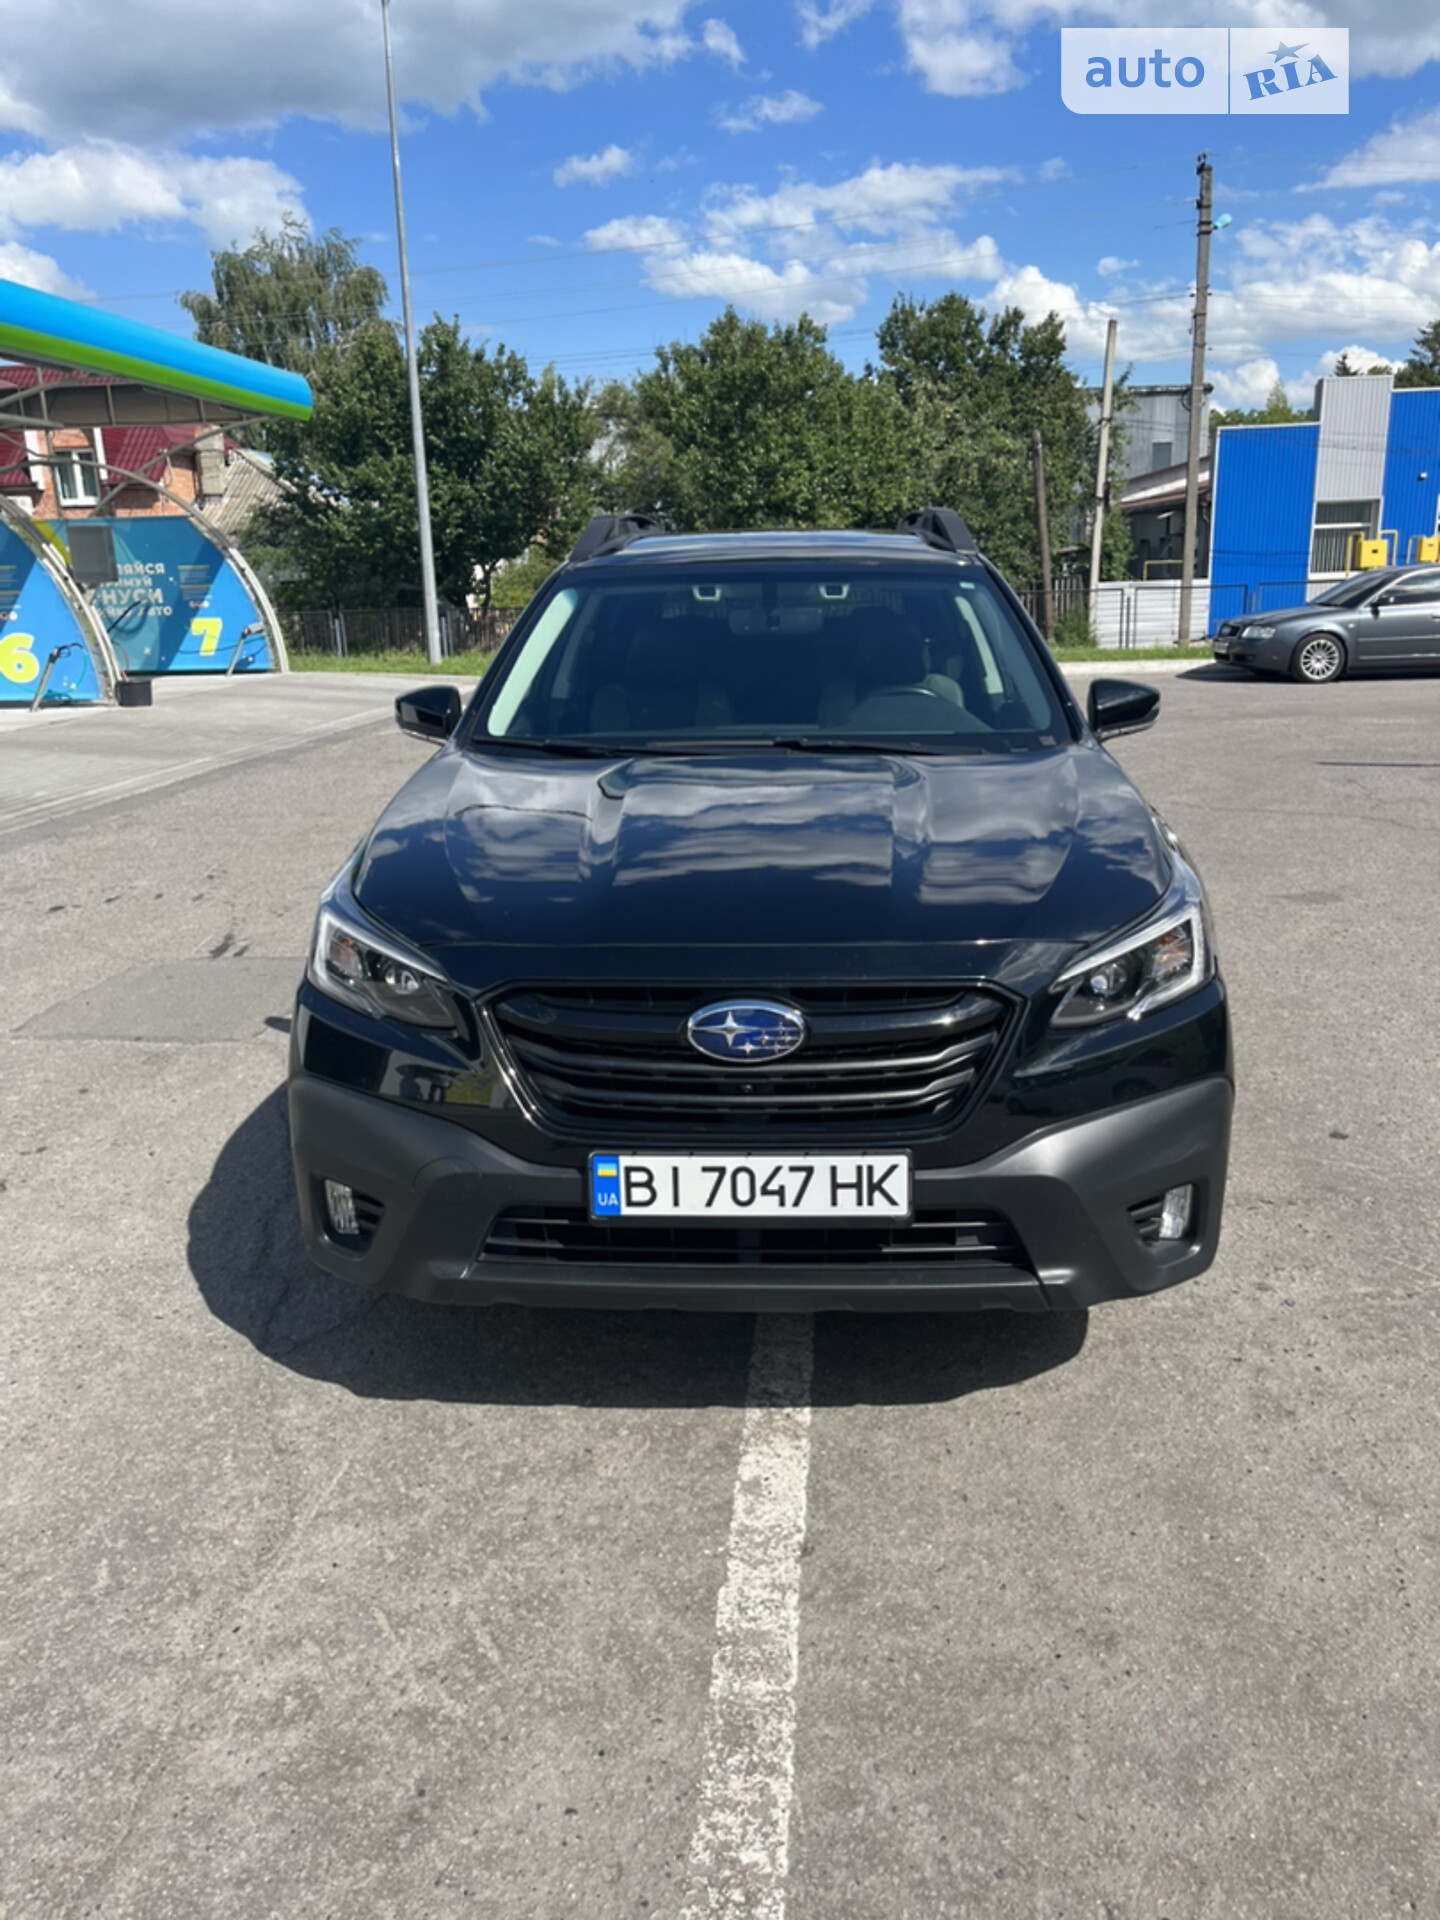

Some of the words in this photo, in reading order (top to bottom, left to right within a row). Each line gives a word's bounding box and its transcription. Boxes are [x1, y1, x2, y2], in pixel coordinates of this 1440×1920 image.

[190, 617, 223, 656] 7
[0, 632, 40, 683] 6
[597, 1194, 619, 1206] UA
[701, 1165, 815, 1207] 7047
